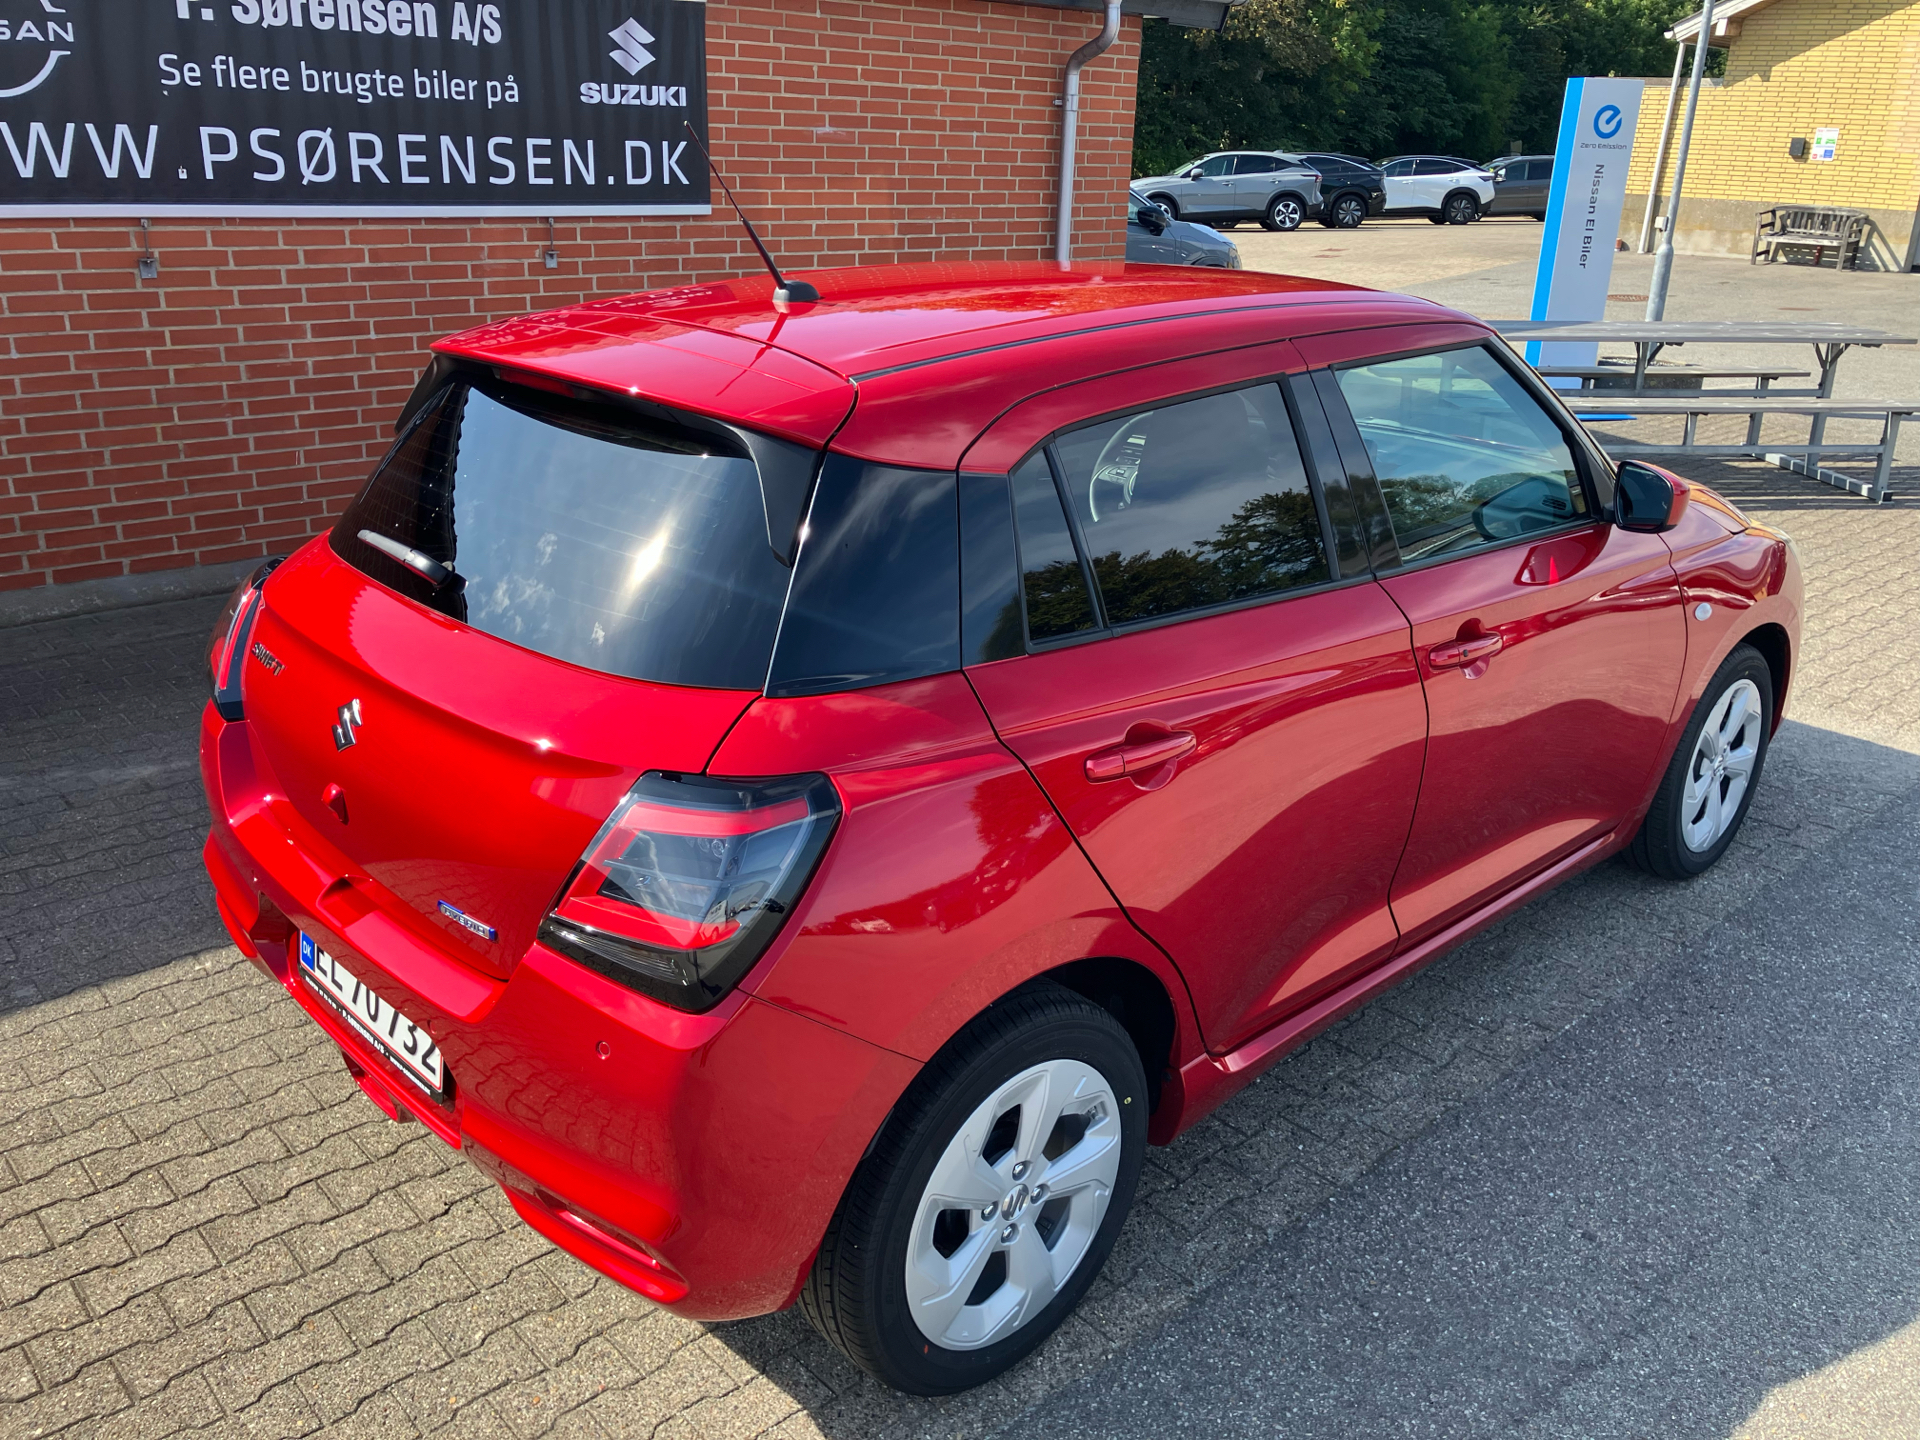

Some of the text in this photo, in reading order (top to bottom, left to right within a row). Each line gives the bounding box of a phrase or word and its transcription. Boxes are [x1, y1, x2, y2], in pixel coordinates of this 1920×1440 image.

[451, 2, 502, 46] A/S
[159, 53, 519, 109] Se flere brugte biler på
[580, 82, 687, 107] SUZUKI
[1579, 164, 1605, 269] Nissan El Biler
[252, 641, 286, 677] SWIFT
[303, 940, 312, 959] DK
